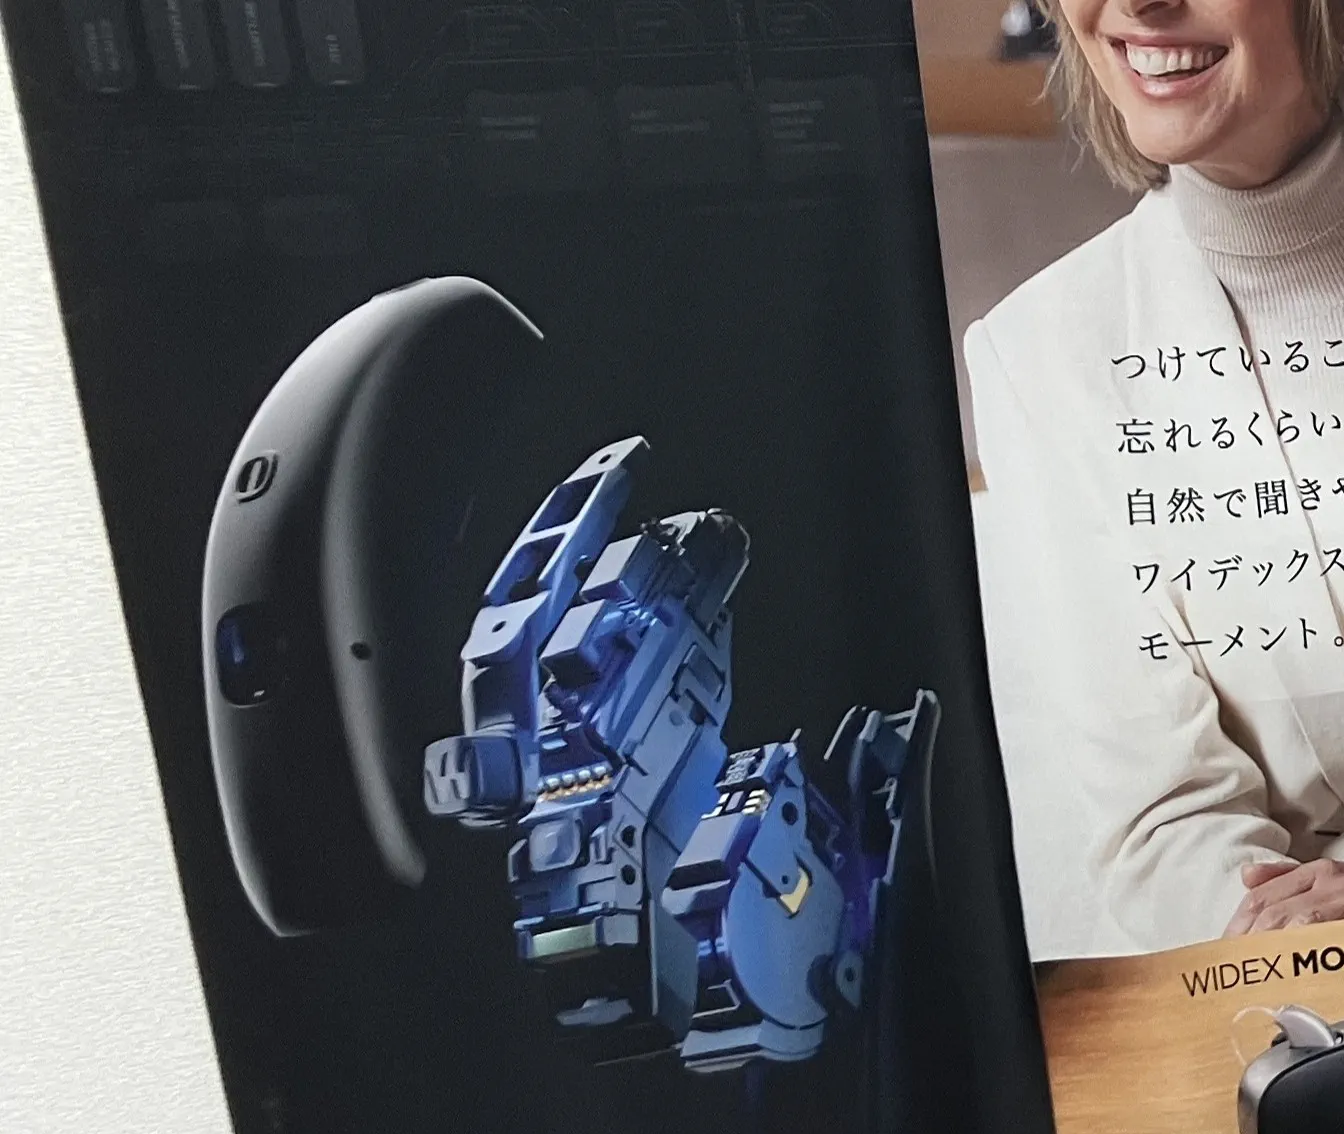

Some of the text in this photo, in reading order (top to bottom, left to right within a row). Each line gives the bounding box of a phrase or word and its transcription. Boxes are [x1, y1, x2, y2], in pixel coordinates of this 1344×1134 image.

[1116, 409, 1343, 454] 忘れるくらい
[1181, 953, 1285, 997] WIDEX
